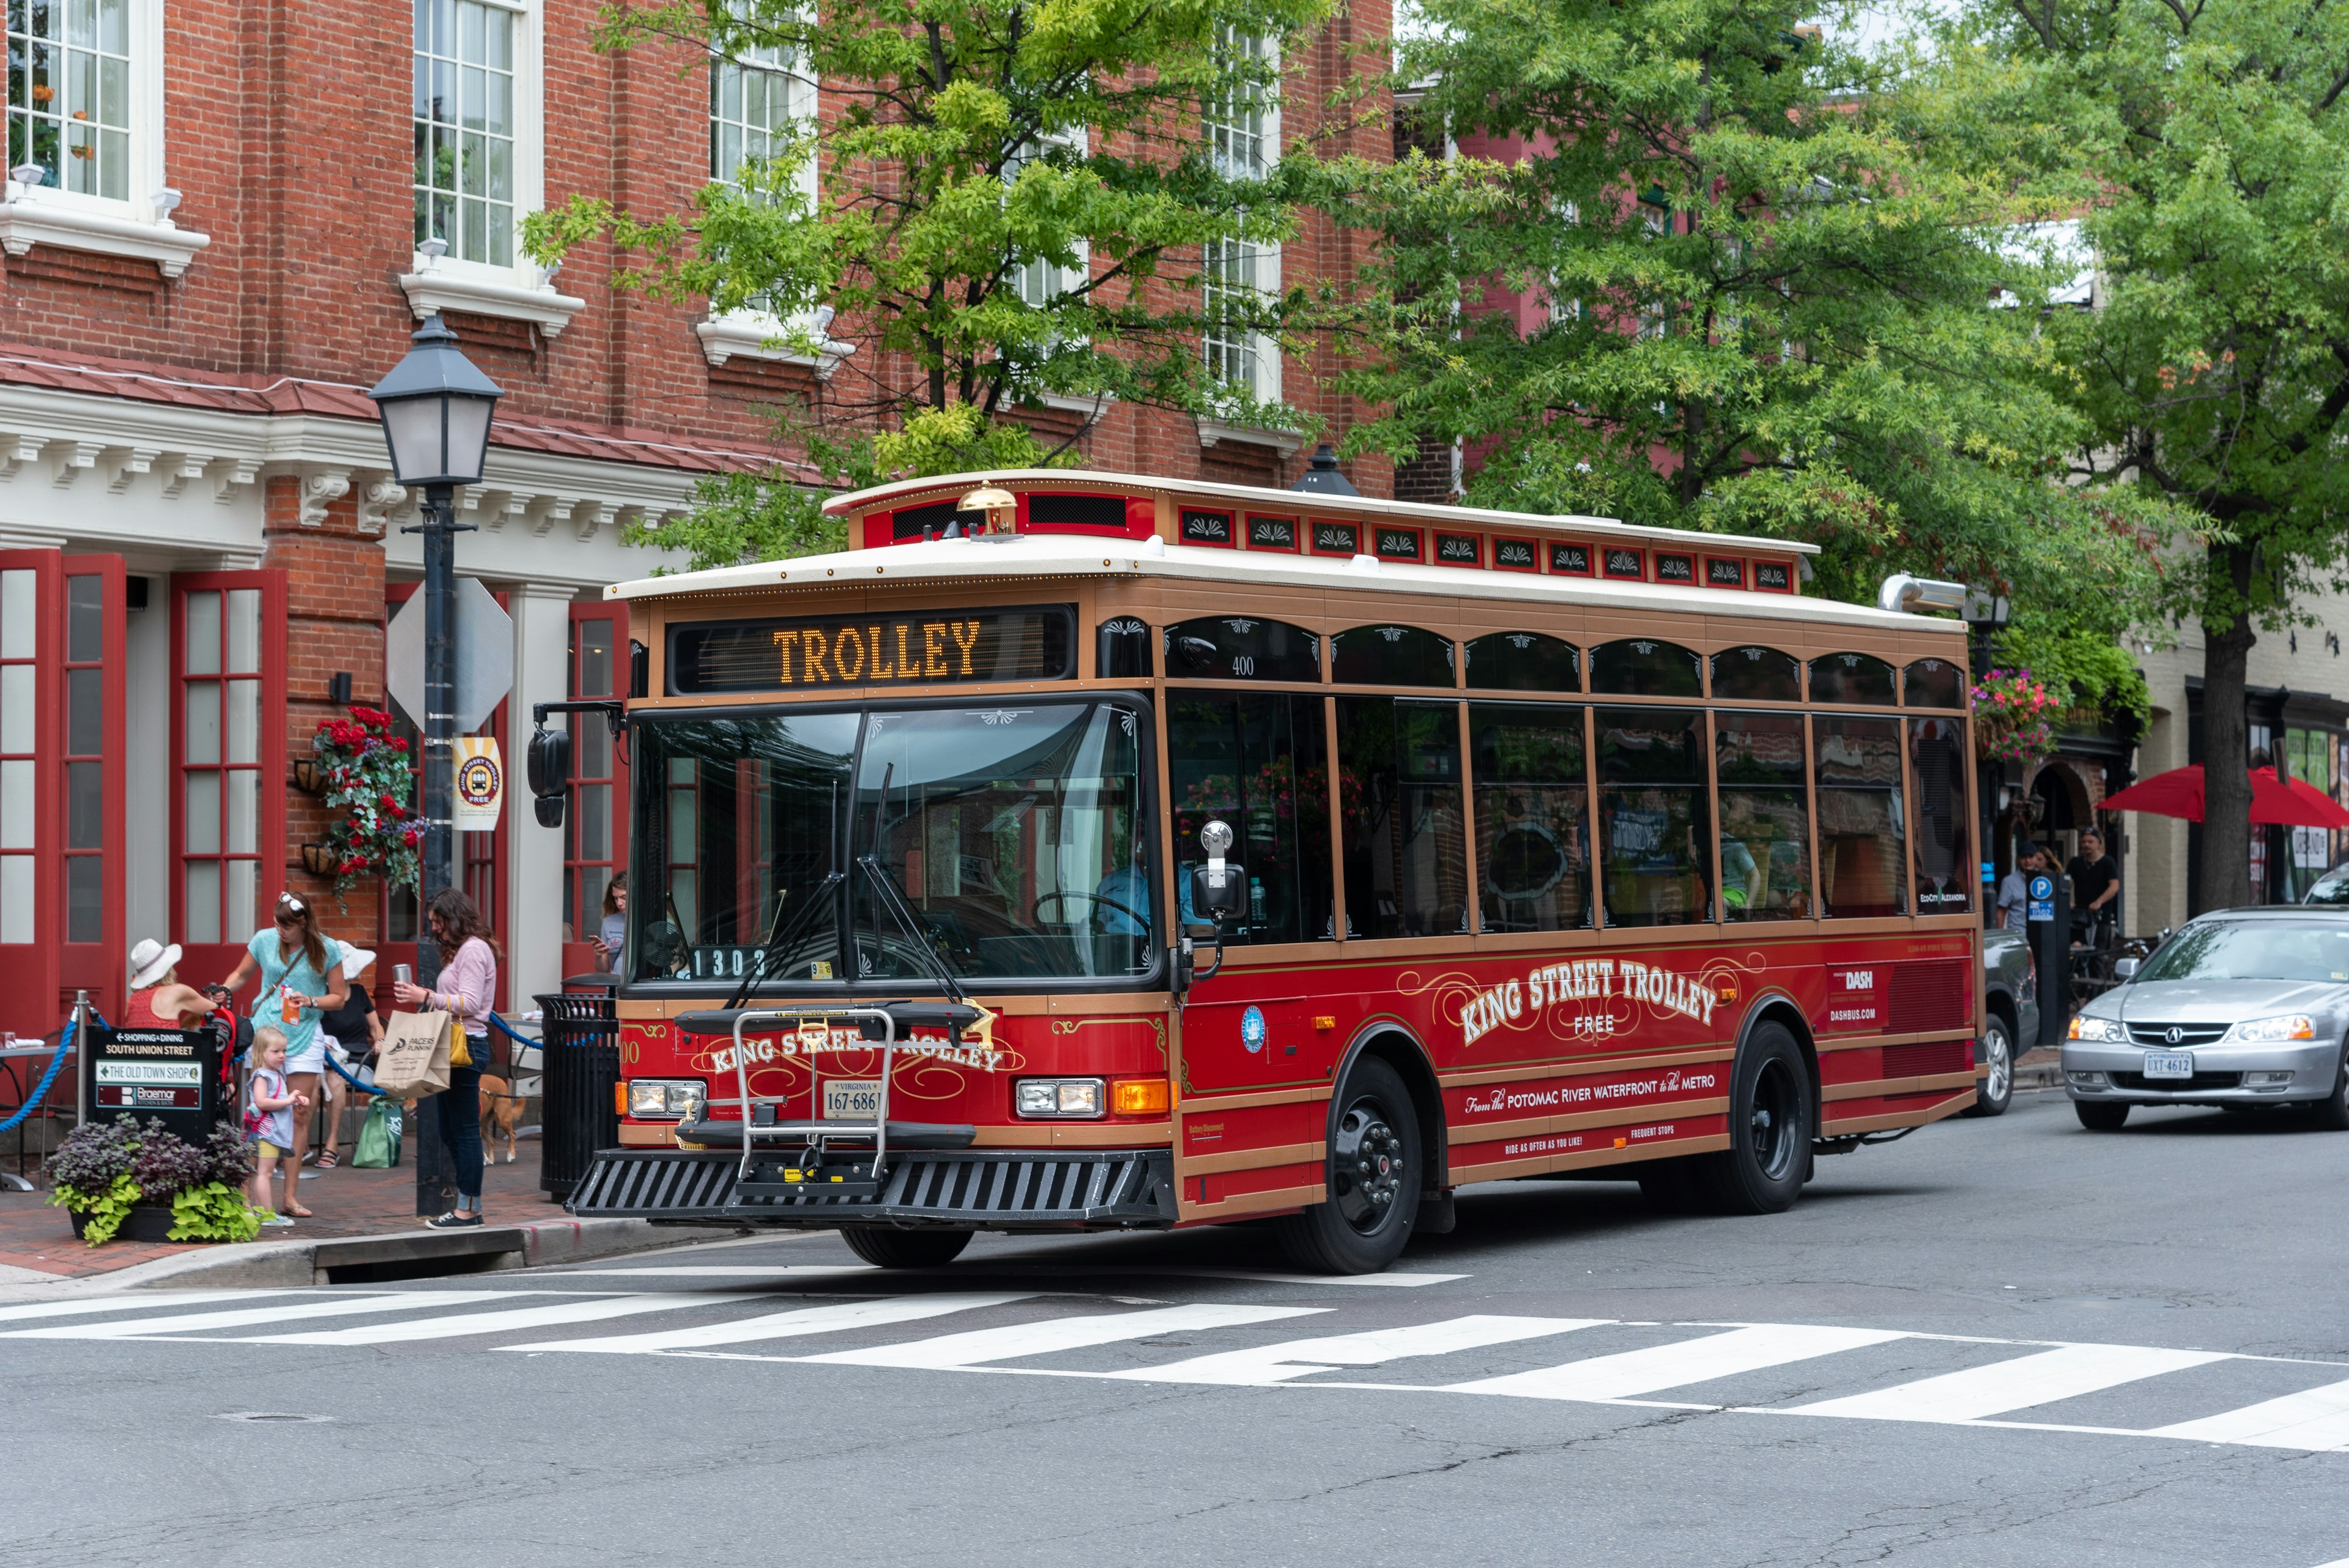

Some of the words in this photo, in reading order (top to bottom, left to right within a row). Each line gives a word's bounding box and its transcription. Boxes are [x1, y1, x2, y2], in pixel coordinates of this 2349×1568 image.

[773, 622, 980, 683] TROLLEY
[1233, 656, 1253, 675] 400
[464, 758, 485, 771] STREET
[485, 759, 499, 792] TROLLEY
[2037, 881, 2047, 896] P
[694, 949, 765, 976] 1303
[812, 964, 817, 974] 9
[825, 965, 831, 974] 18
[1846, 971, 1873, 990] DASH
[1460, 979, 1522, 1045] KING
[1530, 960, 1614, 1009] STREET
[1620, 960, 1716, 1027] TROLLEY
[1830, 1008, 1876, 1021] DASHBUS.COM
[1575, 1014, 1614, 1034] FREE
[124, 1033, 157, 1042] SHOPPING
[160, 1034, 184, 1042] DINING
[106, 1045, 135, 1054] SOUTH
[136, 1046, 163, 1055] UNION
[164, 1046, 194, 1055] STREET
[782, 1029, 874, 1055] STREE
[892, 1033, 1003, 1071] ROLLEY
[110, 1066, 124, 1078] THE
[126, 1066, 141, 1078] OLD
[143, 1067, 165, 1079] TOWN
[167, 1068, 188, 1079] SHOP
[2148, 1060, 2189, 1071] UXT-4612
[137, 1087, 176, 1099] Braemar
[1465, 1097, 1490, 1113] From
[1490, 1088, 1505, 1110] the
[1507, 1092, 1559, 1109] POTOMAC
[1561, 1087, 1591, 1103] RIVER
[1594, 1080, 1658, 1099] WATERFRONT
[1659, 1079, 1666, 1091] to
[1666, 1070, 1680, 1091] the
[1681, 1074, 1715, 1090] METRO
[1189, 1126, 1203, 1134] Battery
[1203, 1123, 1224, 1132] Disconnect
[1631, 1126, 1657, 1139] FREQUENT
[1658, 1125, 1674, 1135] STOPS
[1505, 1143, 1518, 1154] RIDE
[1520, 1143, 1527, 1153] AS
[1529, 1142, 1546, 1152] OFTEN
[1548, 1140, 1555, 1150] AS
[1556, 1138, 1567, 1148] YOU
[1568, 1136, 1583, 1147] LIKE!
